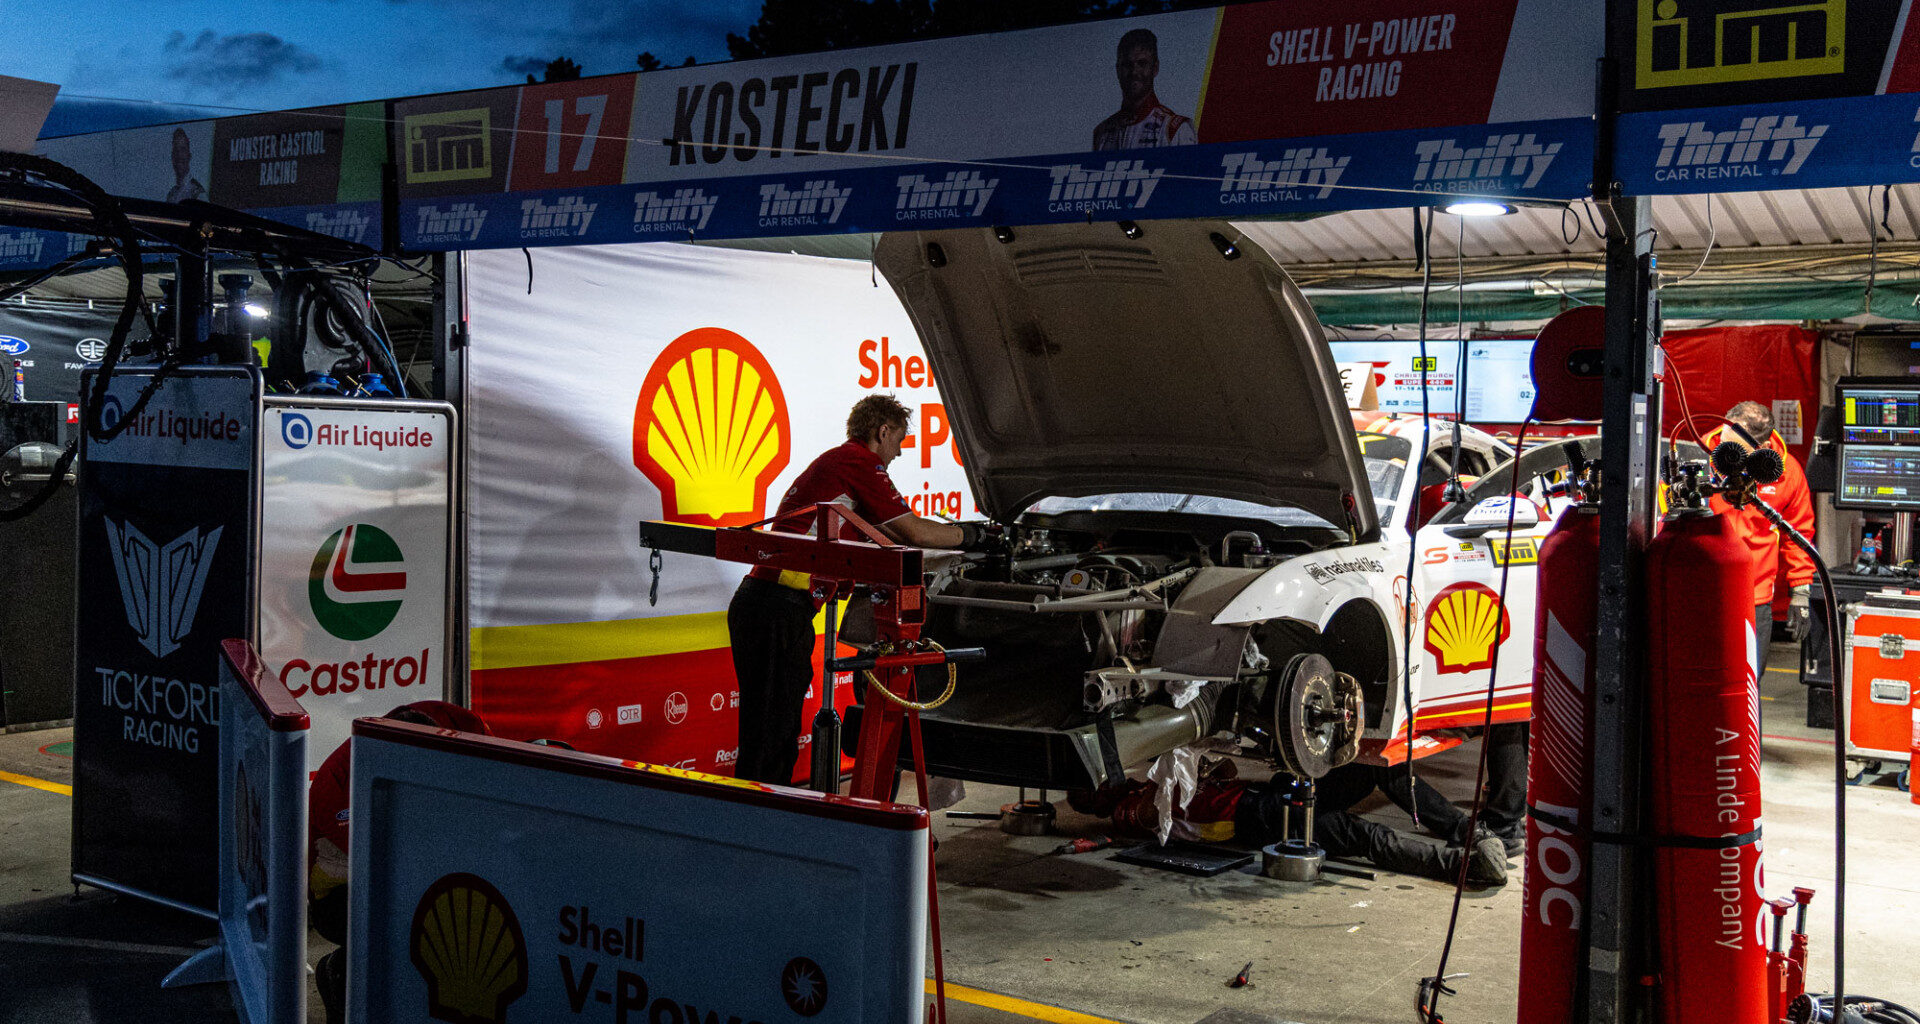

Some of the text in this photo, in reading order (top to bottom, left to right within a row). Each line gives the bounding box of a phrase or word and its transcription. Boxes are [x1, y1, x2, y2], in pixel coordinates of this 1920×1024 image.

[1266, 13, 1456, 67] SHELL V-POWER
[1315, 60, 1403, 103] RACING
[544, 94, 608, 174] 17
[669, 62, 918, 166] KOSTECKI
[229, 129, 326, 161] MONSTER CASTROL
[1412, 133, 1564, 189] Thrifty
[1655, 115, 1830, 175] Thrifty
[259, 160, 298, 186] RACING
[1048, 159, 1166, 209] Thrifty
[1219, 147, 1352, 199] Thrifty
[1412, 179, 1506, 193] CAR RENTAL
[1654, 165, 1762, 181] CAR RENTAL
[633, 188, 719, 230] Thrifty
[759, 180, 853, 224] Thrifty
[895, 170, 1000, 217] Thrifty
[1048, 200, 1121, 213] CAR RENTAL
[1219, 190, 1302, 204] CAR RENTAL
[417, 203, 489, 241] Thrifty
[520, 196, 598, 236] Thrifty
[520, 228, 570, 238] CAR RENTAL
[633, 222, 686, 233] CAR RENTAL
[759, 215, 818, 228] CAR RENTAL
[895, 208, 960, 221] CAR RENTAL
[417, 233, 462, 243] CAR RENTAL
[858, 336, 937, 389] She
[158, 410, 240, 445] Liquide
[317, 424, 433, 451] Air Liquide
[279, 647, 430, 699] Castrol
[123, 715, 199, 754] RACING
[619, 708, 640, 721] OTR
[1713, 727, 1746, 951] A Linde ompany
[1534, 799, 1582, 930] BOC
[558, 905, 645, 962] Shell
